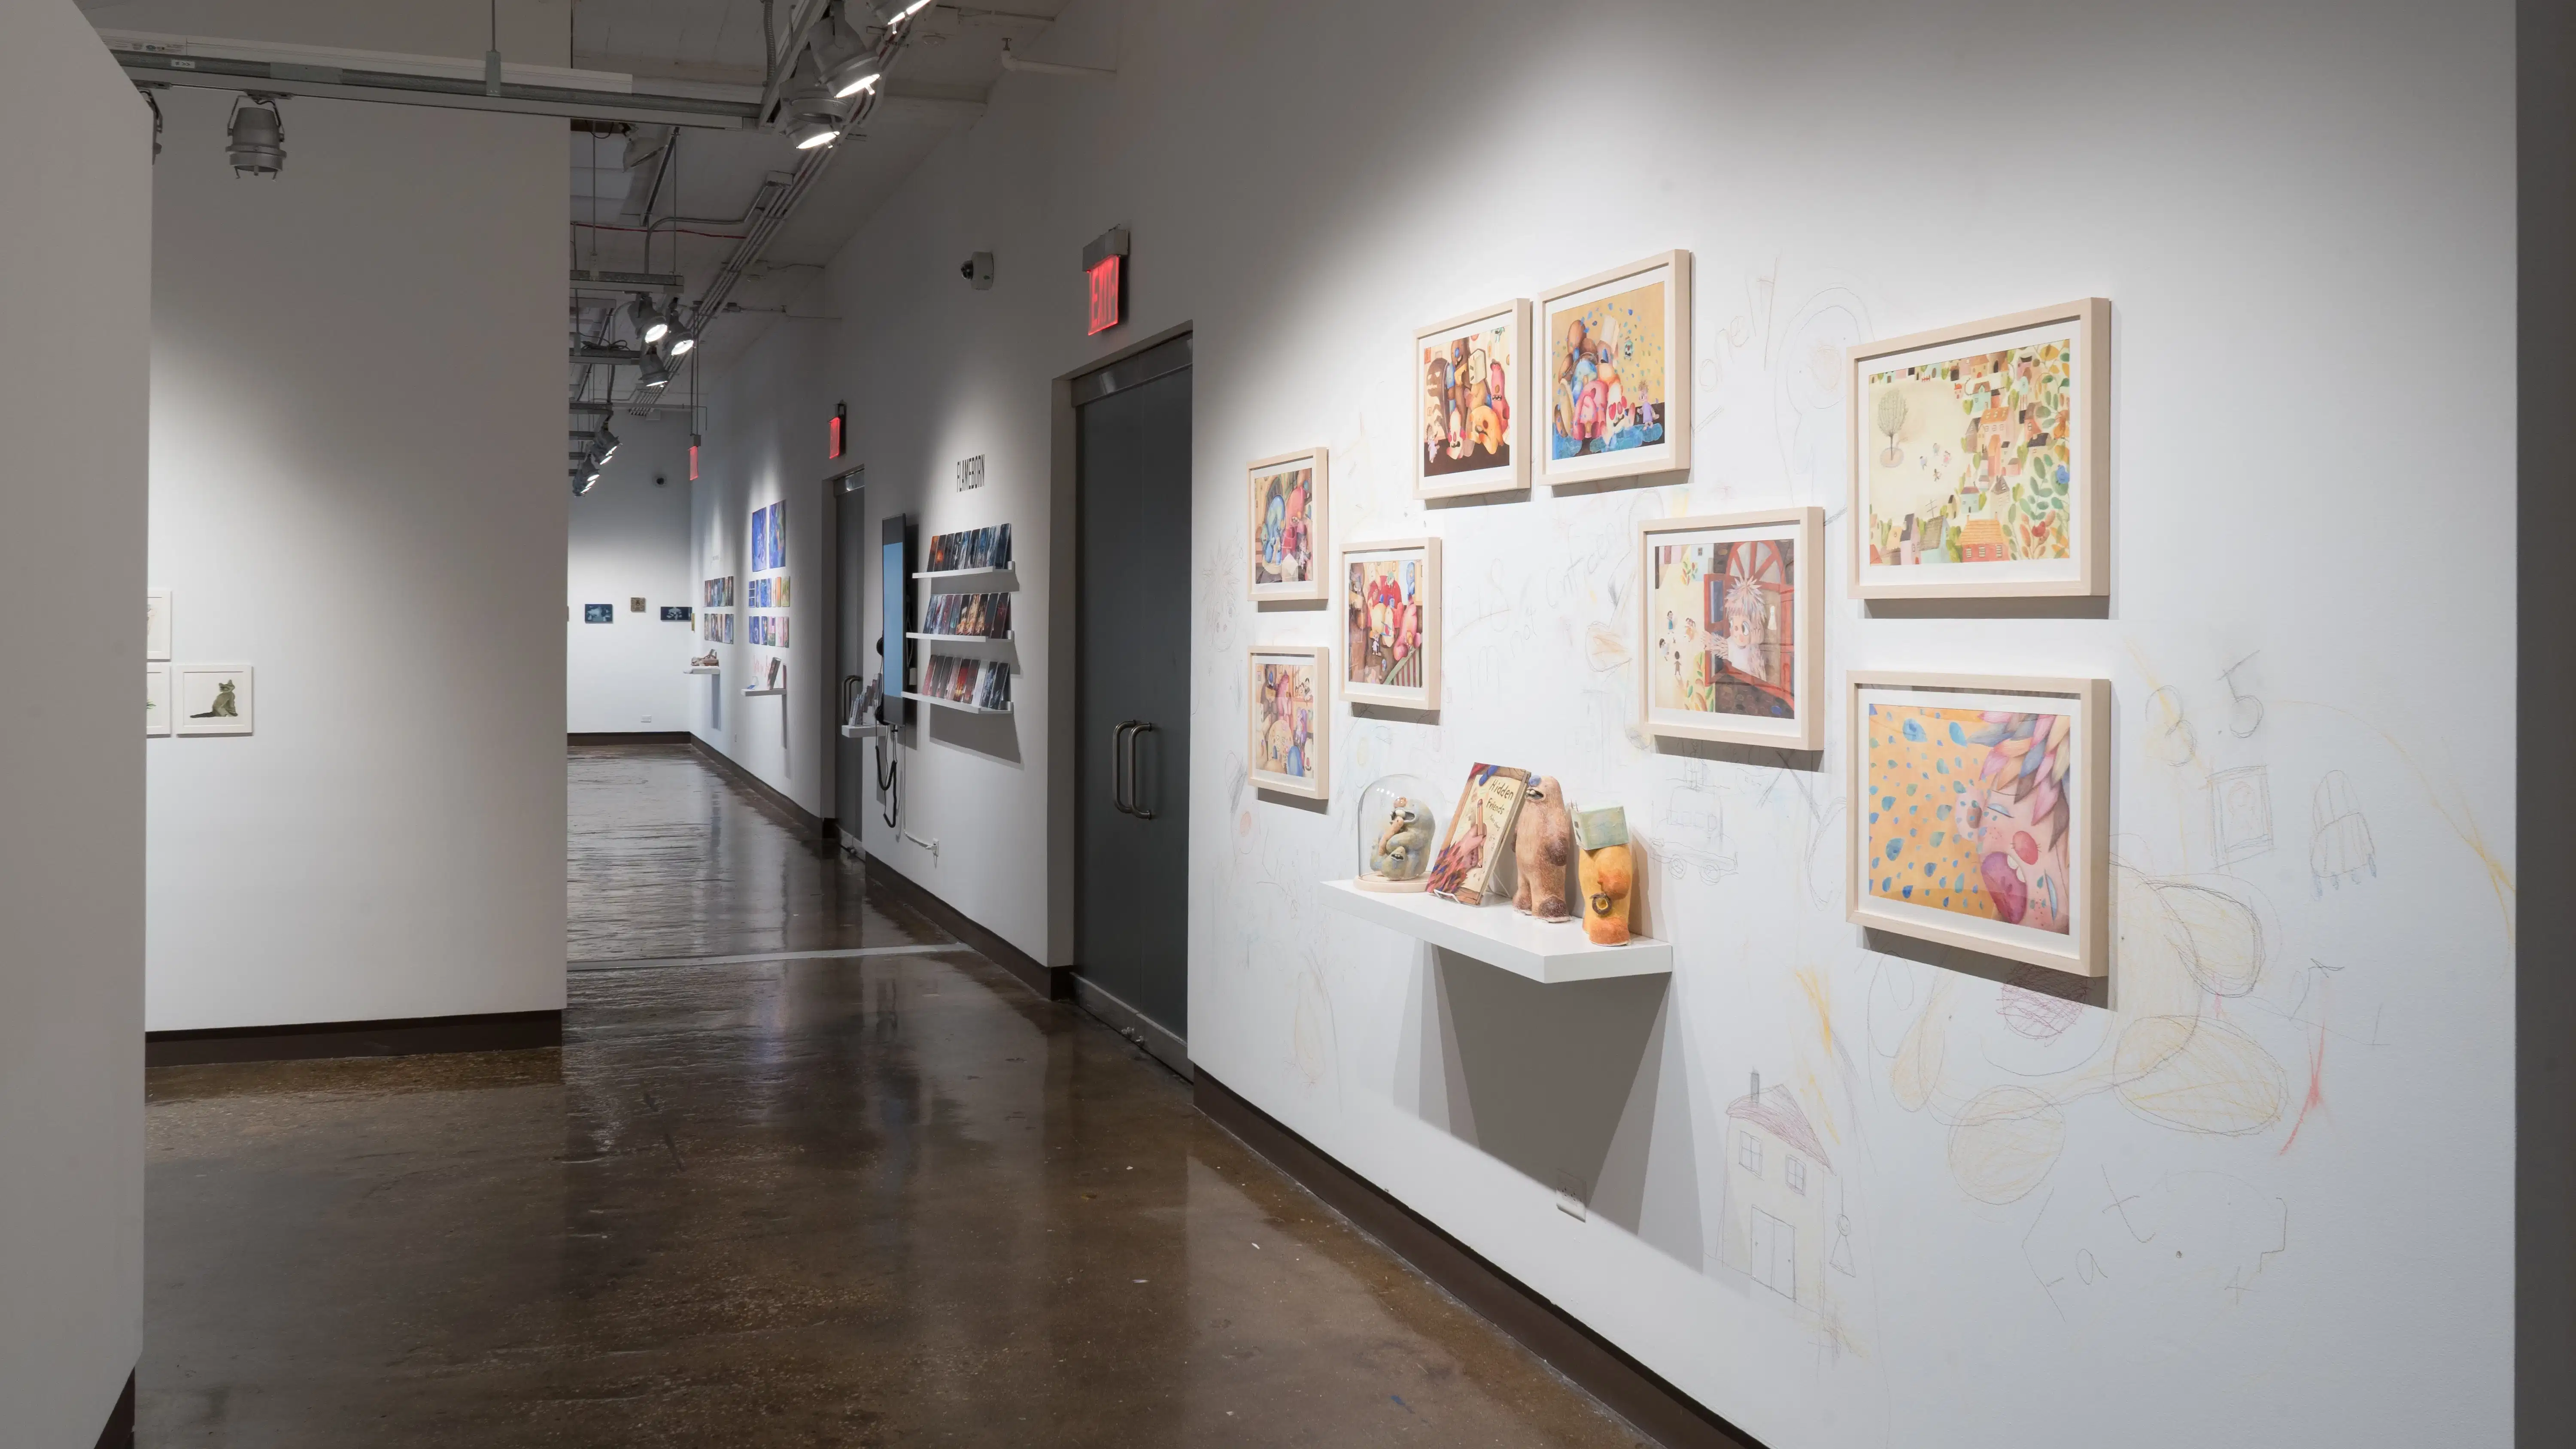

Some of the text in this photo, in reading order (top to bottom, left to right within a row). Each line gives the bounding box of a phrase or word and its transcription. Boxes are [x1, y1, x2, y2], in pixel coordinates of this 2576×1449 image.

[957, 453, 985, 493] FLAMEBORN
[1488, 779, 1514, 800] Hidden
[1486, 797, 1505, 815] Friends
